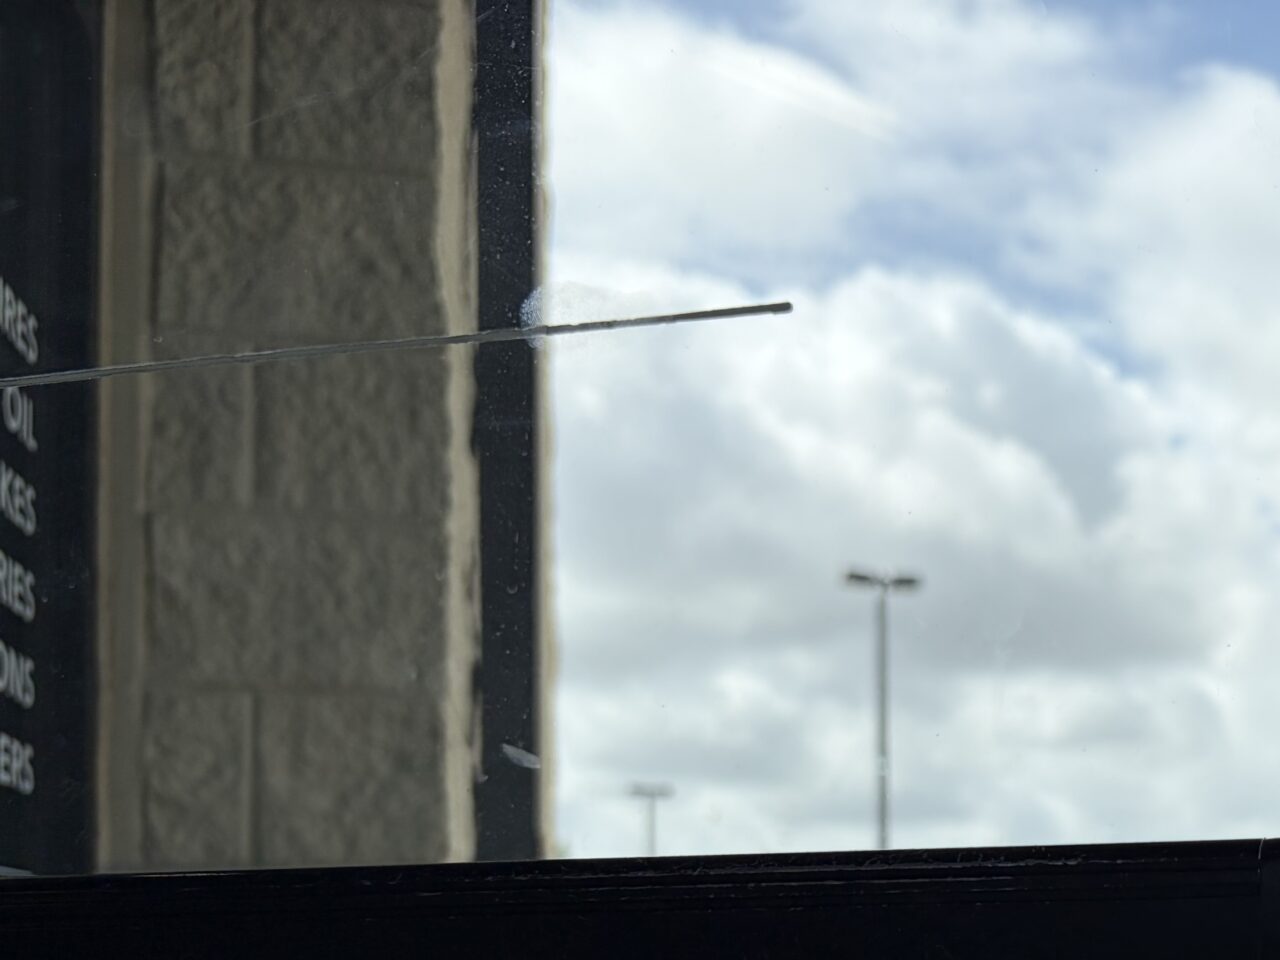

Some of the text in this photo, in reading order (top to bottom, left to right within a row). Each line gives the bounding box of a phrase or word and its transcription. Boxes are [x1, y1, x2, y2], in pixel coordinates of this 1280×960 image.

[2, 384, 39, 450] OIL
[0, 458, 37, 537] KES
[0, 731, 35, 795] ERS
